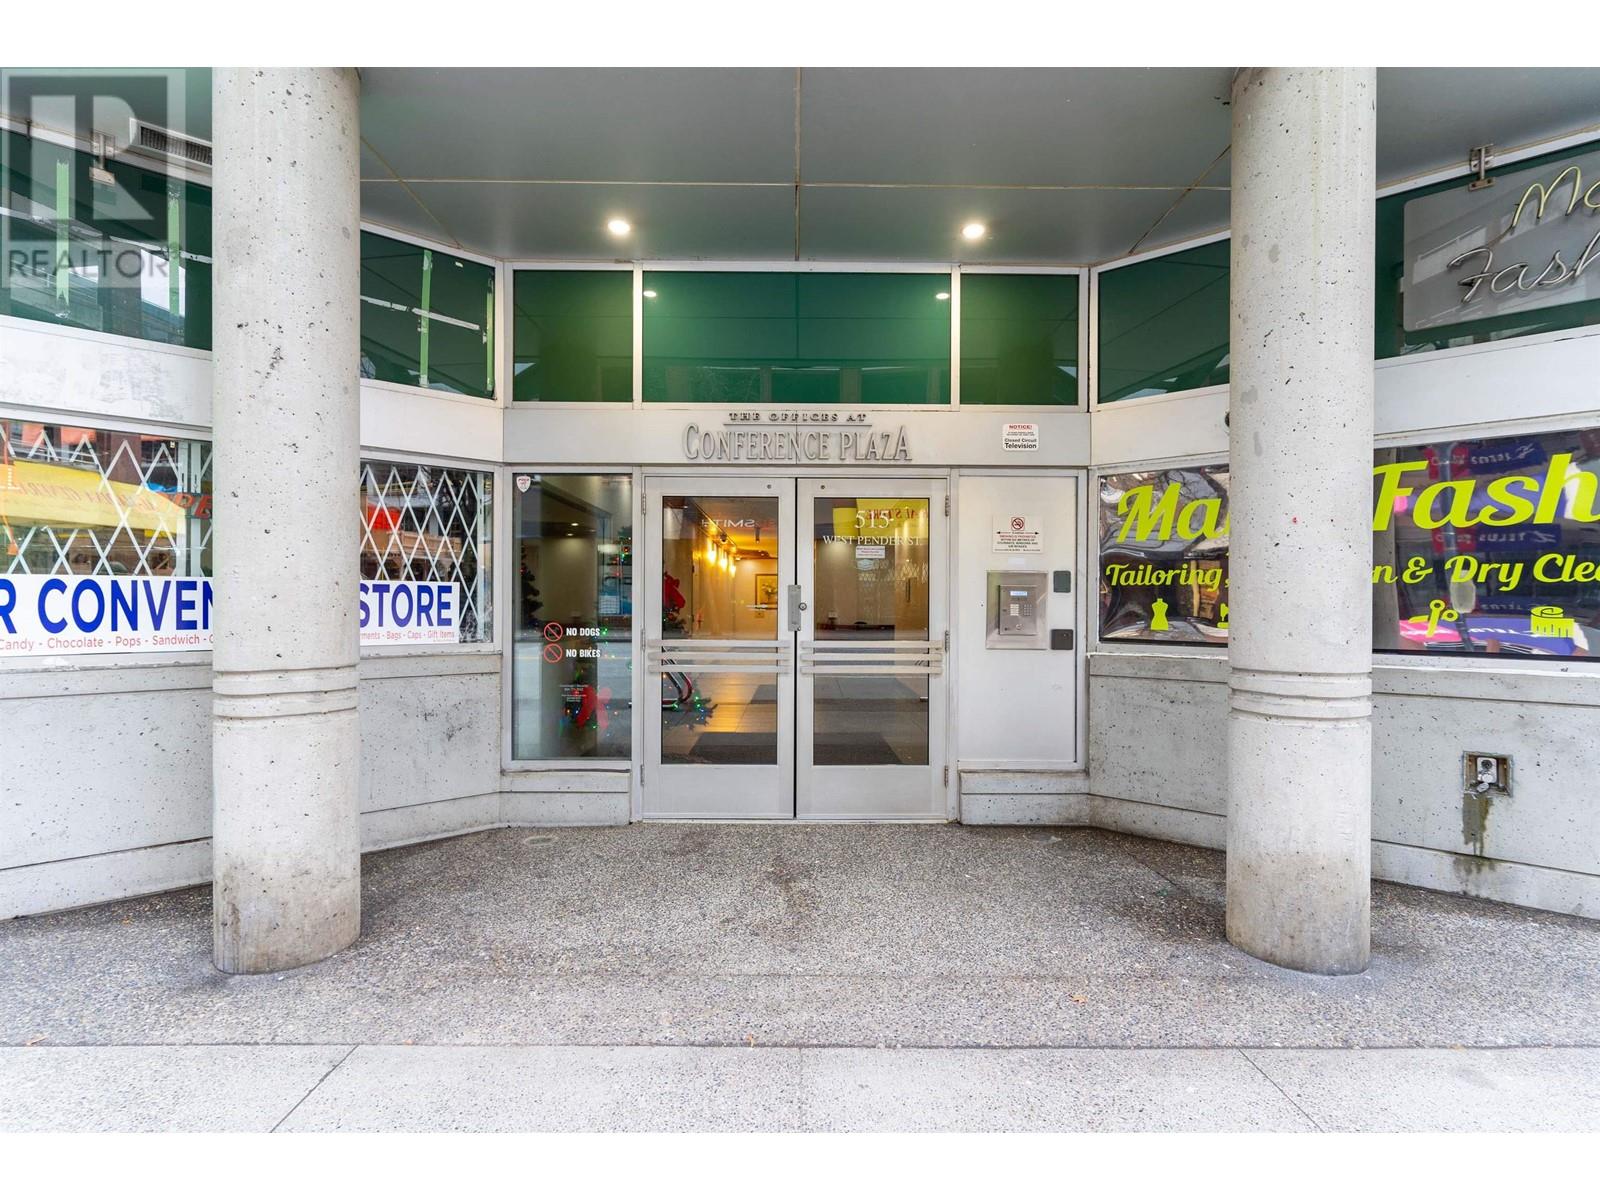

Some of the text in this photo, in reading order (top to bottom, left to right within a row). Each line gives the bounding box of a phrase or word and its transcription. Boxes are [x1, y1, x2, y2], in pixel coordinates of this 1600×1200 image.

[729, 412, 867, 423] THE OFFICES AT
[683, 423, 913, 462] CONFERENCE PLAZA
[854, 510, 890, 529] 515
[822, 535, 854, 545] WEST
[857, 535, 904, 546] PENDER
[1402, 556, 1434, 584] &
[1444, 555, 1524, 592] Dry
[566, 627, 601, 637] NO DOGS
[47, 636, 104, 649] Chocolate
[115, 634, 142, 648] Pops
[152, 632, 200, 646] Sandwich
[565, 649, 601, 658] NO BIKES
